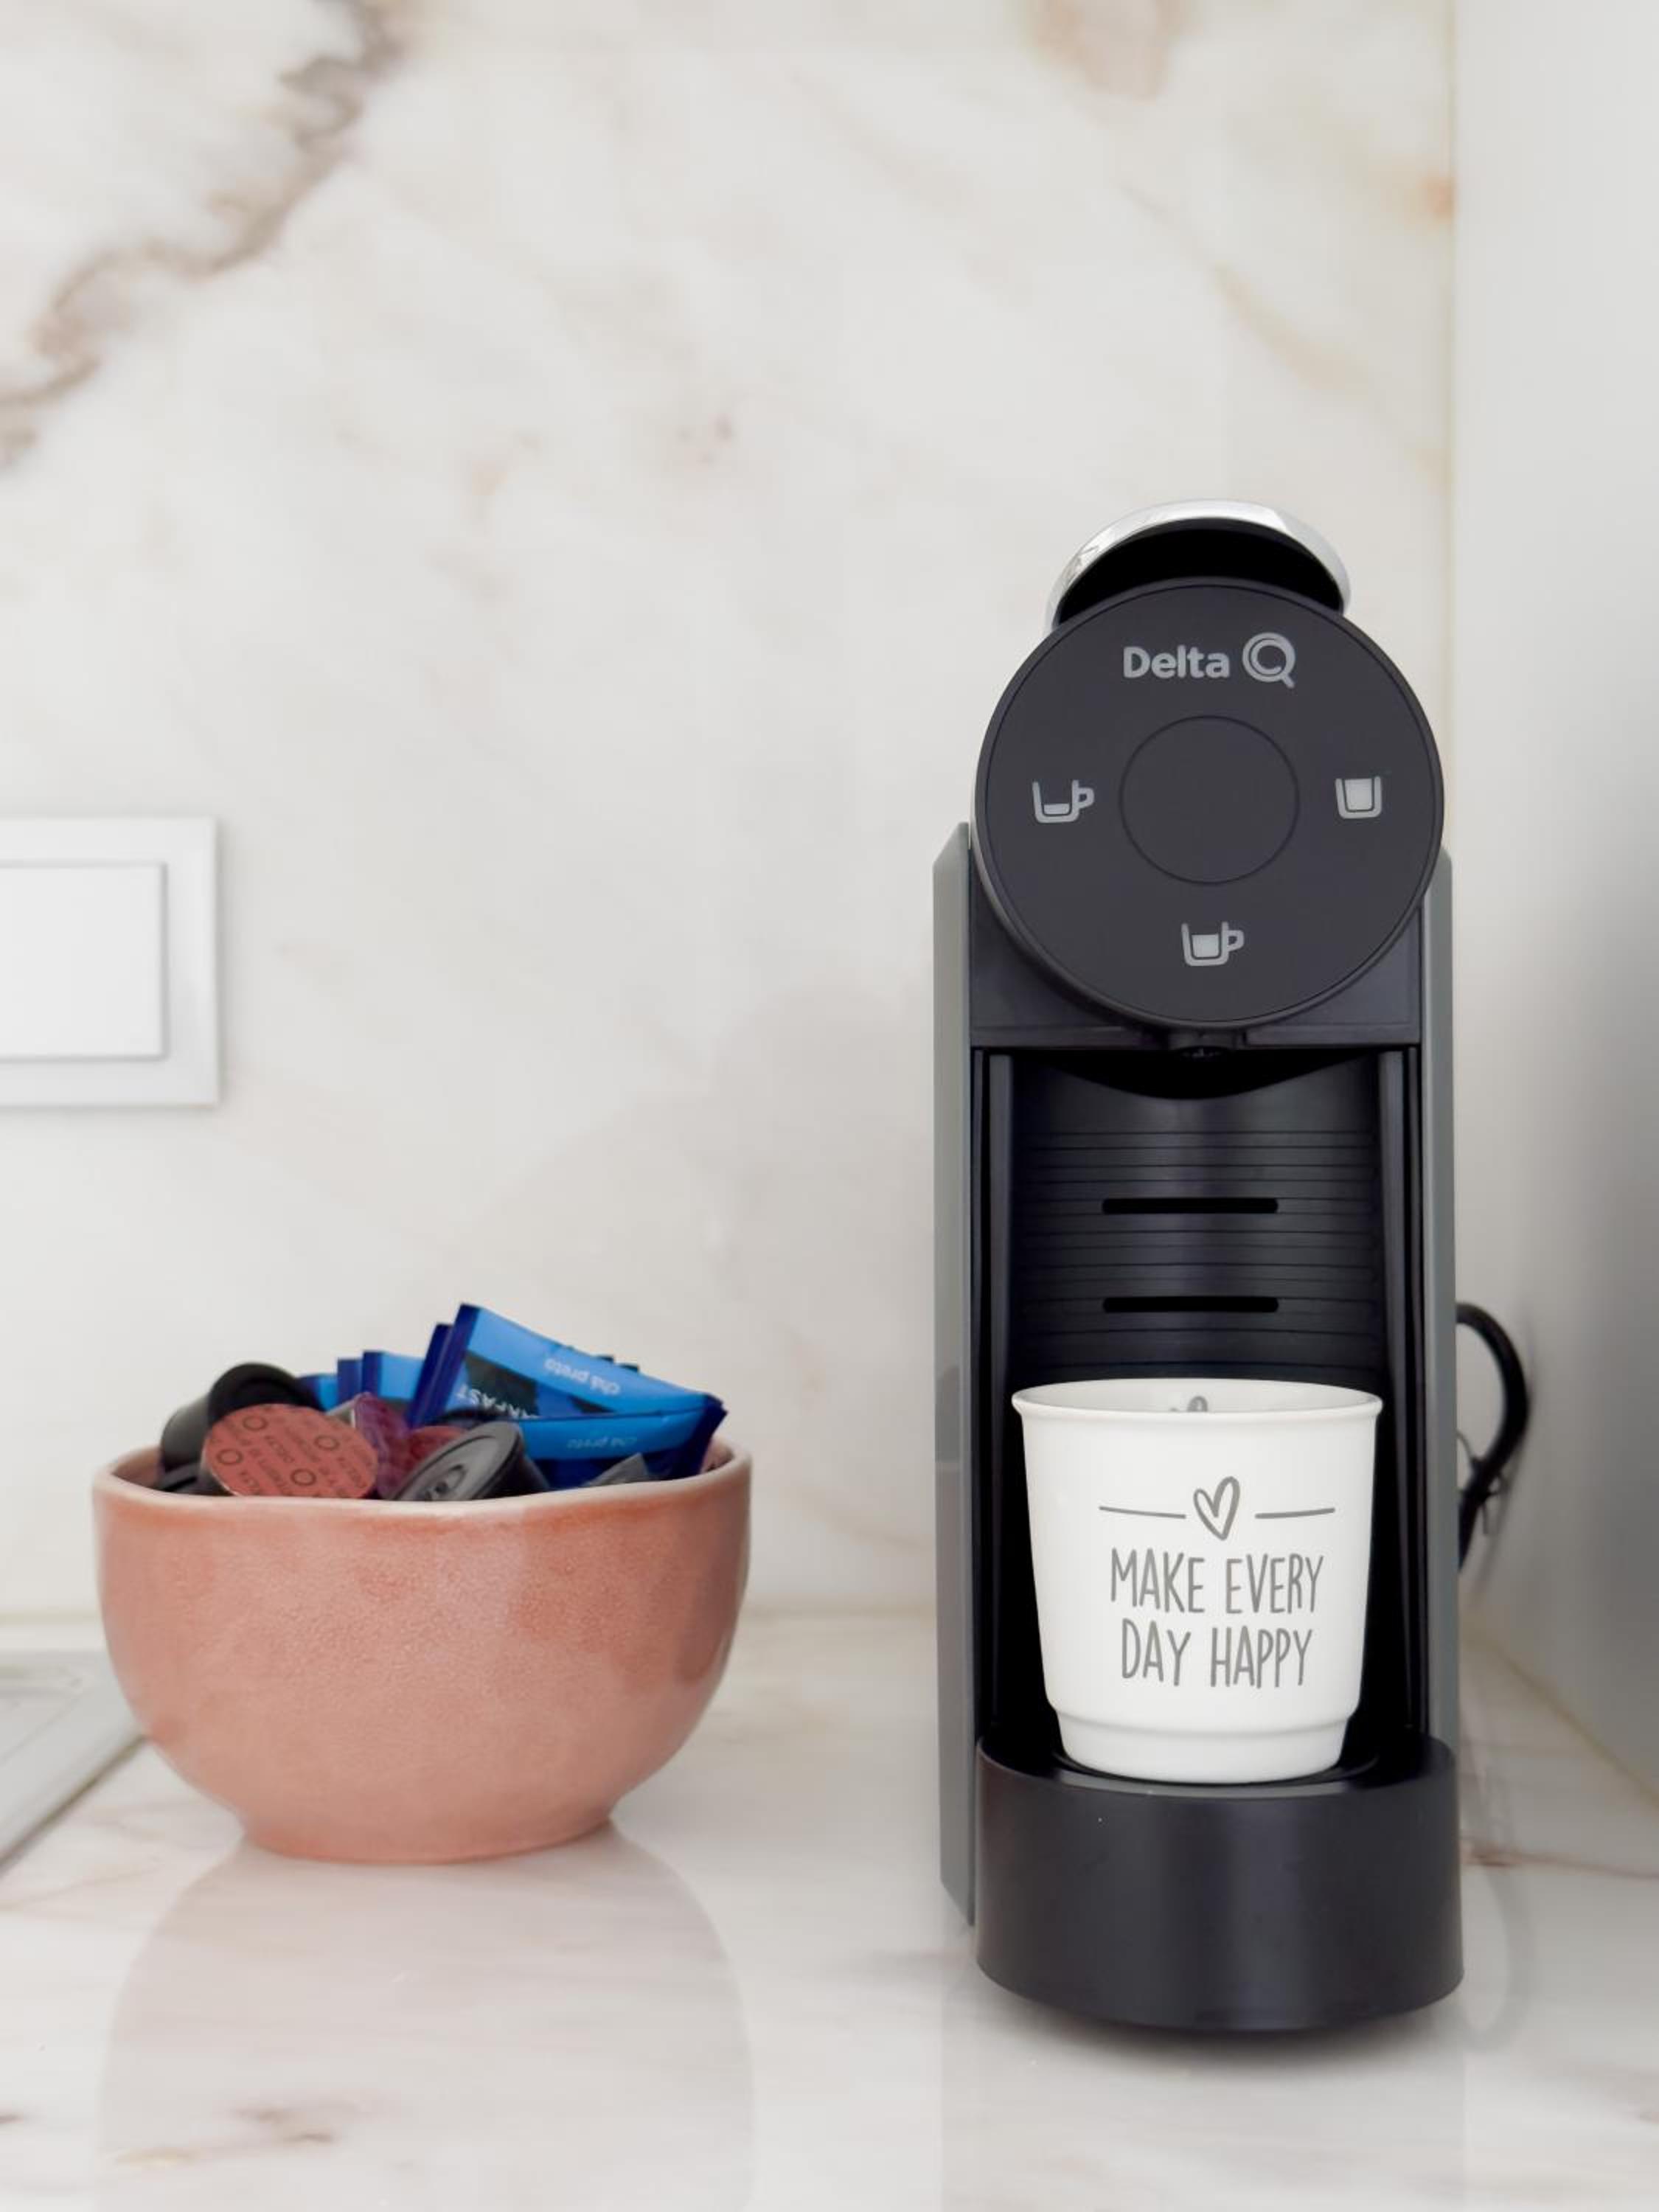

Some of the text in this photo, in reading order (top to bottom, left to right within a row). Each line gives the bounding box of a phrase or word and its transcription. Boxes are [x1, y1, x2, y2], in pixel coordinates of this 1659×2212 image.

[1124, 633, 1295, 687] Delta Q
[544, 1357, 590, 1383] preto
[1111, 1548, 1324, 1614] MAKE EVERY
[1122, 1618, 1312, 1688] DAY HAPPY
